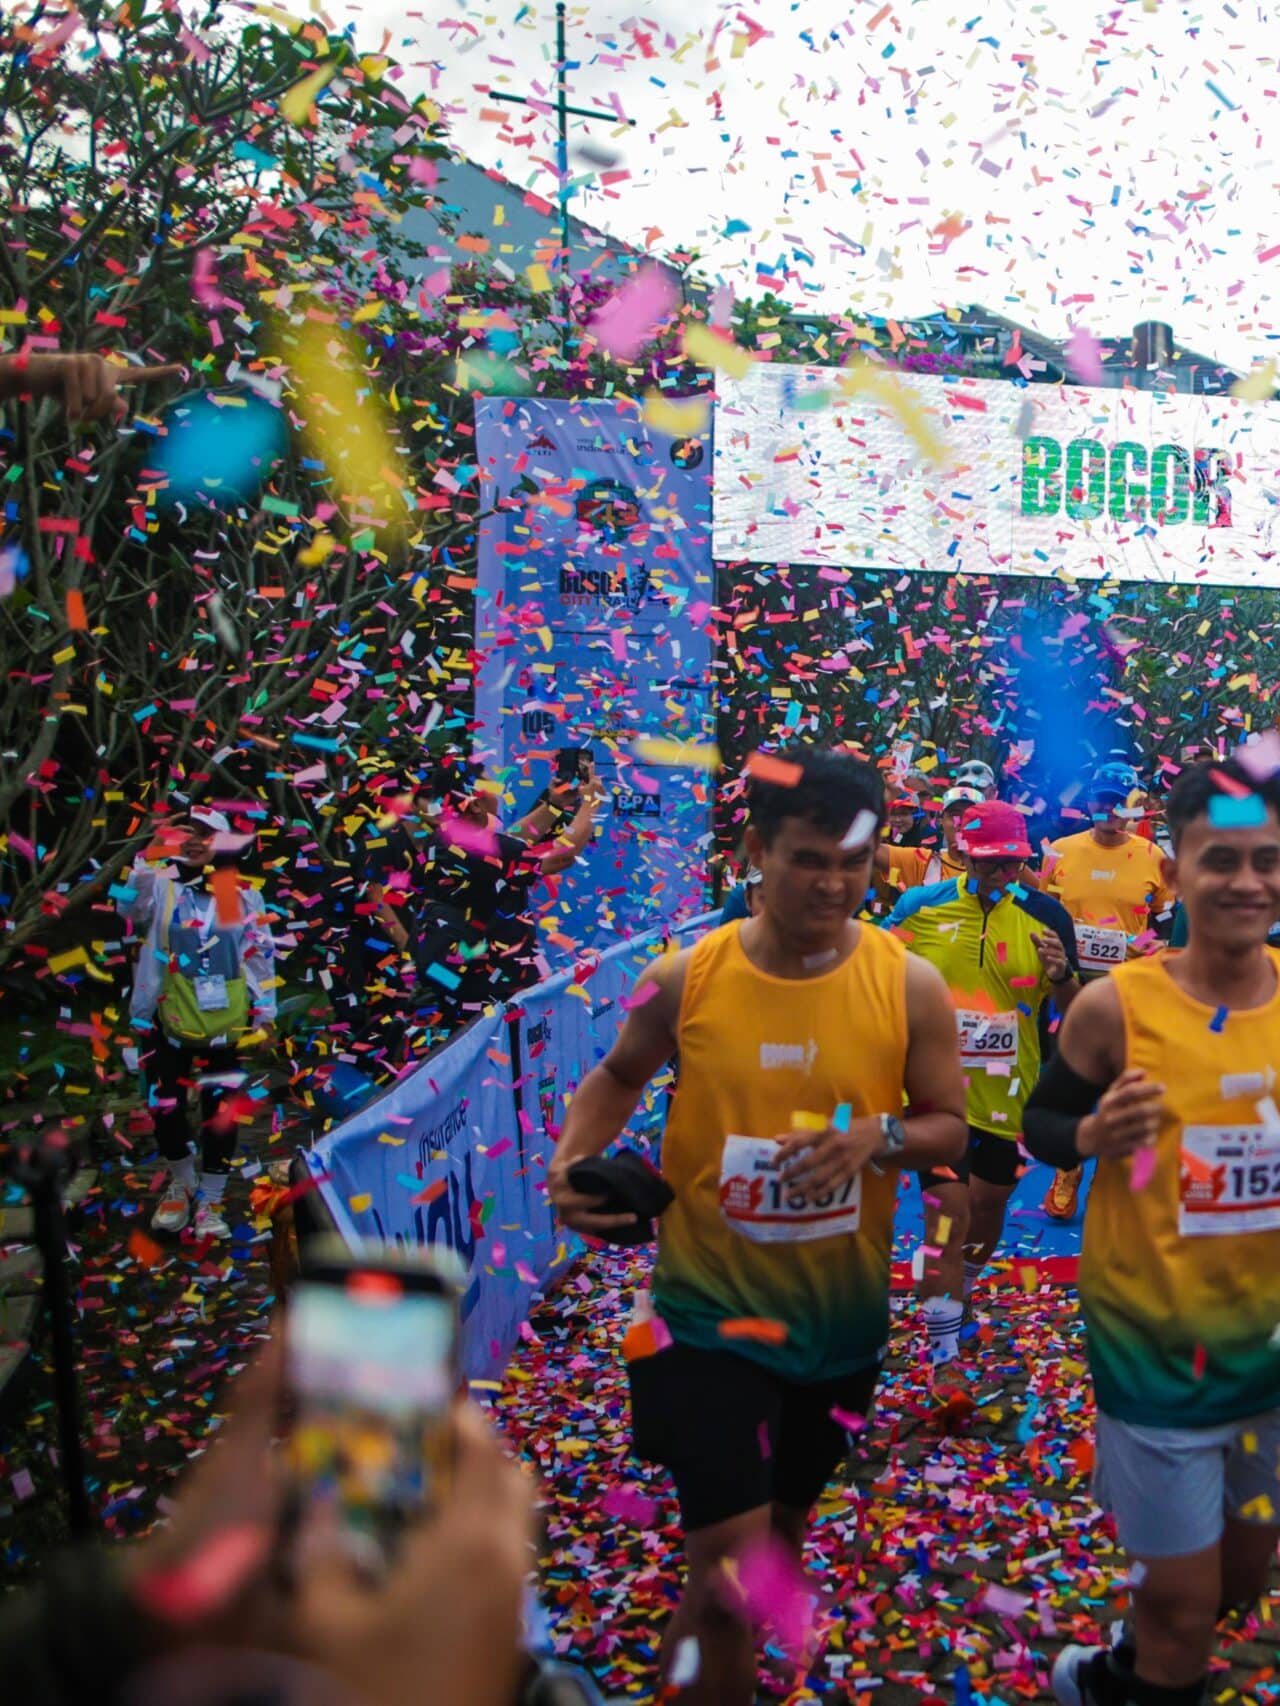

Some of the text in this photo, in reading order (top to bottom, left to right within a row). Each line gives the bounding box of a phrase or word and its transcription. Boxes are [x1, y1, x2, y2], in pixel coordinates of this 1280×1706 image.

[1021, 436, 1233, 528] BOGOR
[1090, 943, 1120, 959] 522
[975, 1033, 1014, 1050] 520
